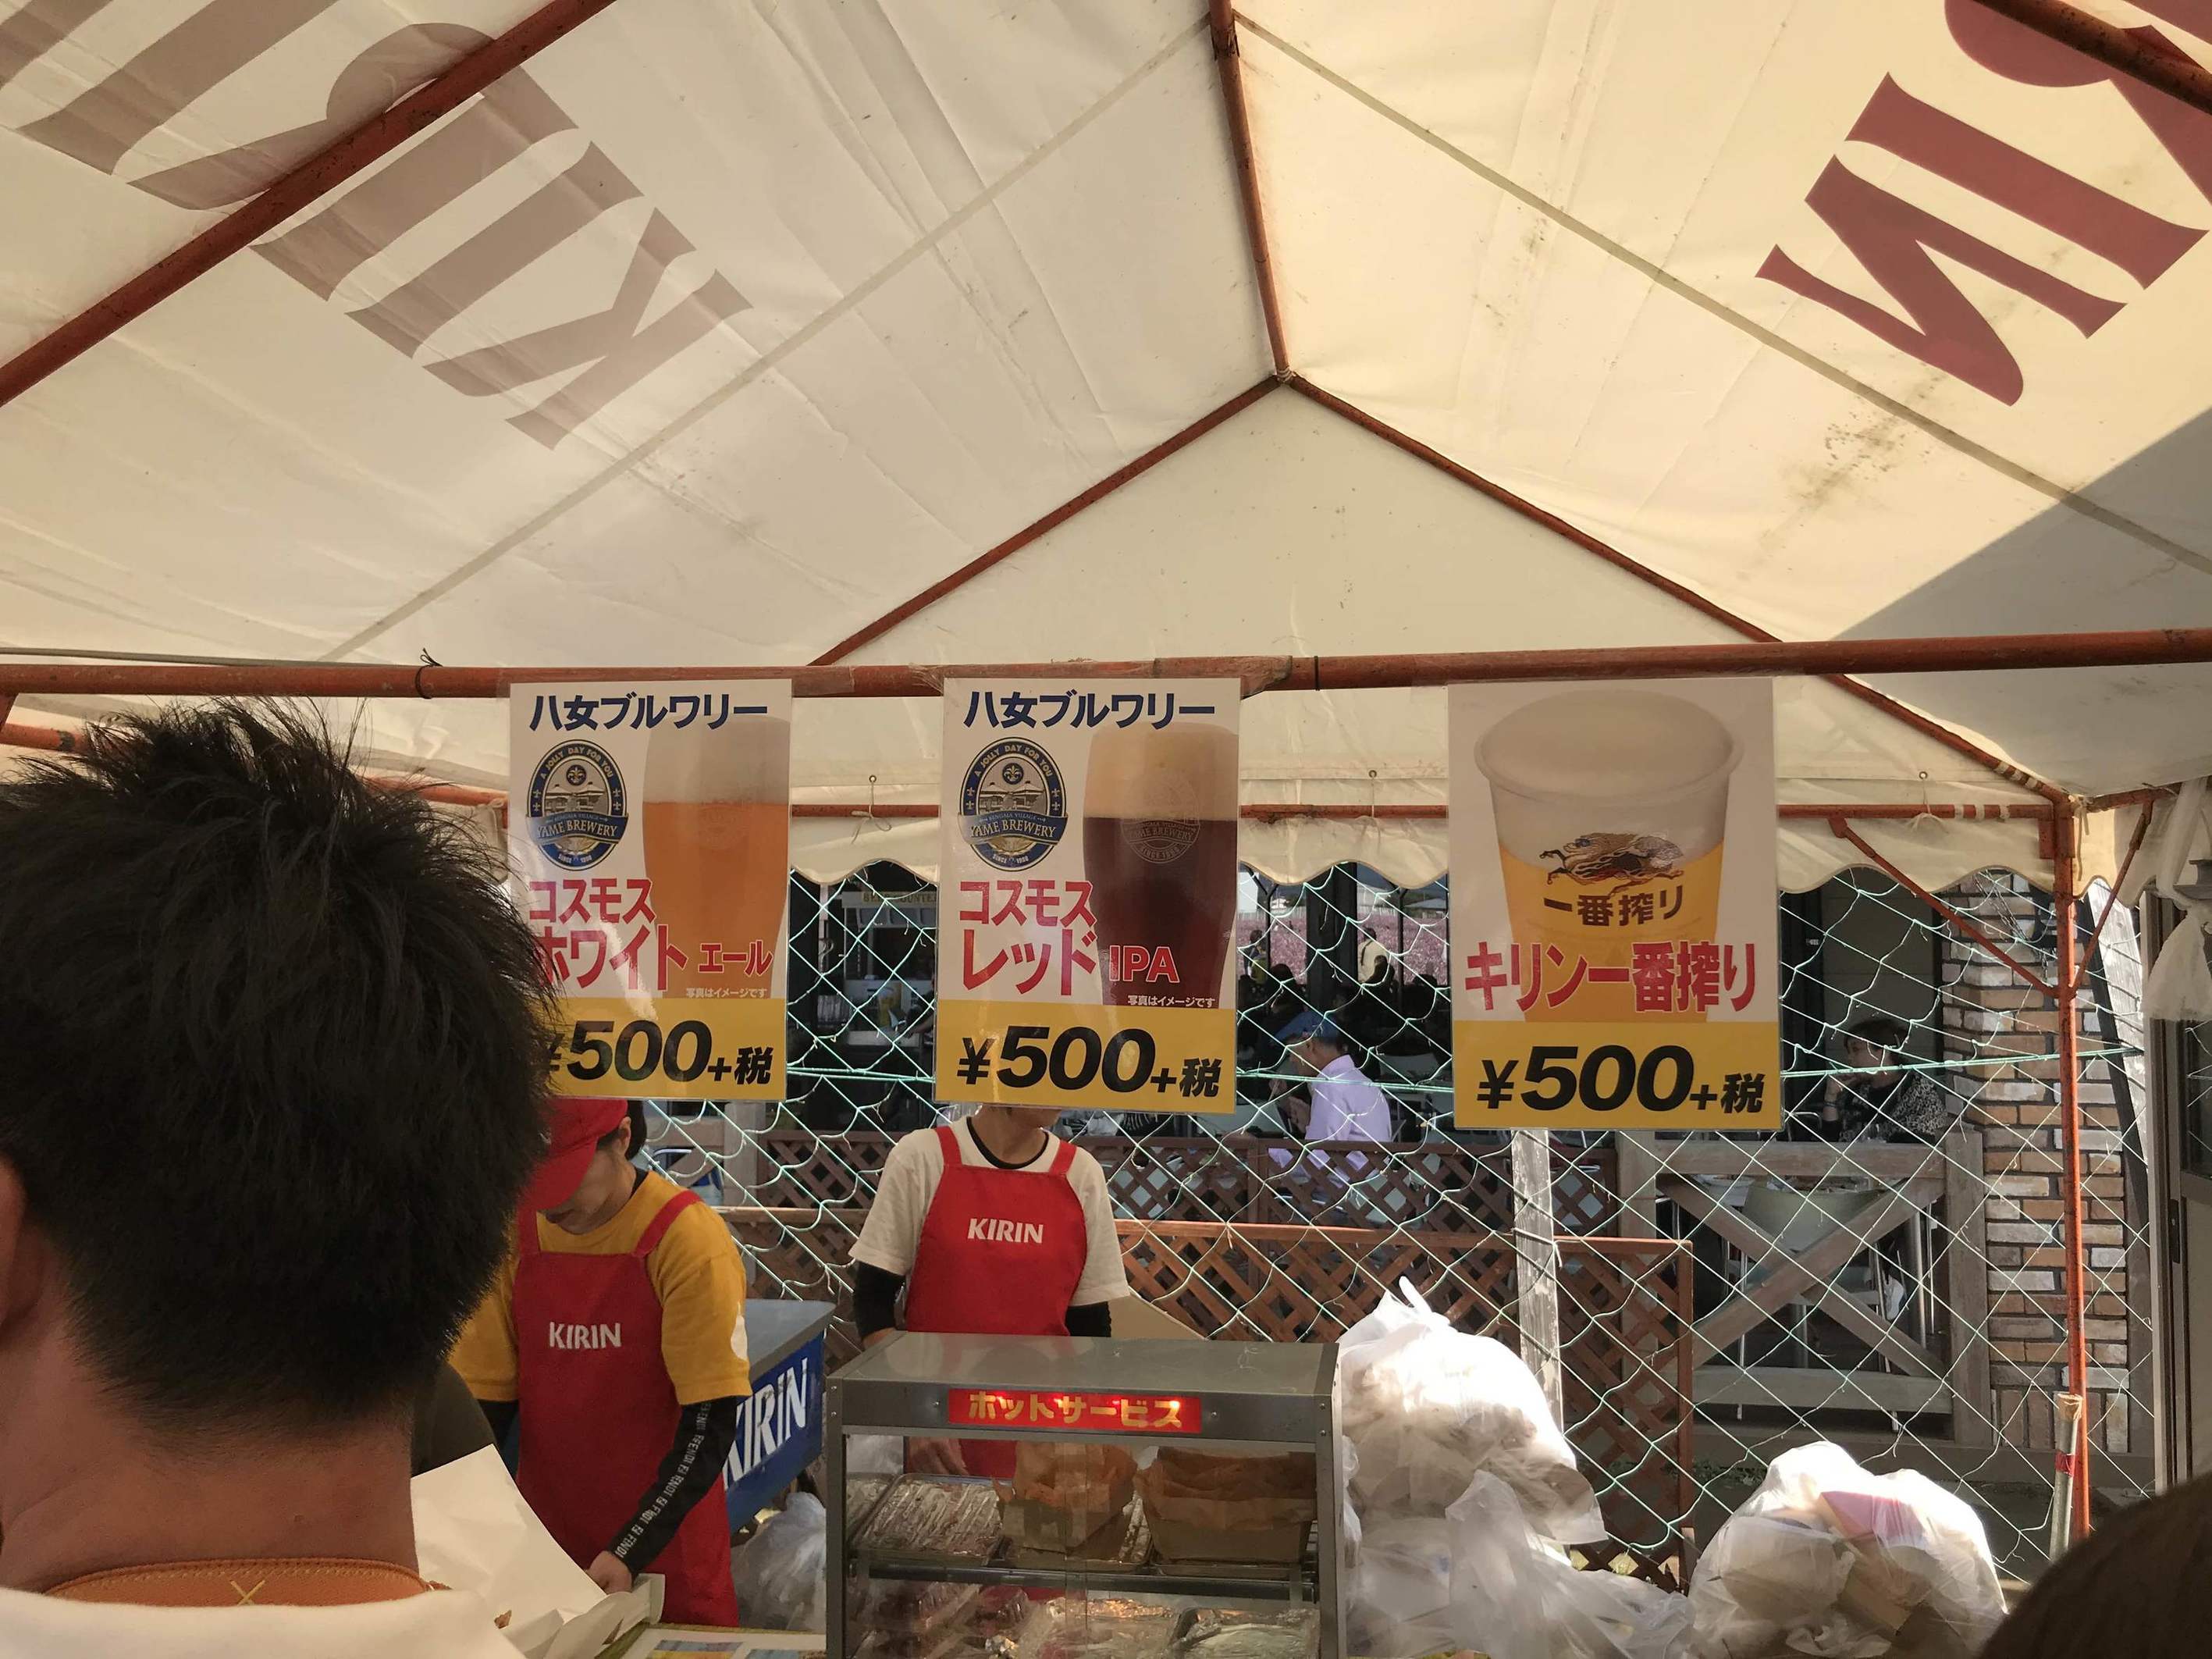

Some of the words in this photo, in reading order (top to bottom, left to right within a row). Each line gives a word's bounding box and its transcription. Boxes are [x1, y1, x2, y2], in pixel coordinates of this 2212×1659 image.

[529, 692, 767, 731] 八女ブルワリー
[963, 689, 1214, 730] 八女ブルワリー
[587, 749, 601, 762] FOR
[601, 763, 613, 778] YOU
[980, 749, 1000, 767] JOLLY
[1024, 746, 1039, 760] FOR
[1040, 761, 1053, 777] YOU
[538, 821, 566, 838] YAME
[567, 818, 617, 837] BREWERY
[970, 821, 1001, 838] YAME
[1002, 819, 1056, 838] BREWERY
[529, 878, 656, 924] コスモス
[959, 880, 1097, 927] コスモス
[1543, 885, 1683, 927] 一番搾り
[698, 941, 773, 976] エール
[962, 929, 1097, 996] レッド
[1108, 945, 1179, 984] IPA
[685, 987, 768, 999] 写真はイメージです
[1465, 942, 1756, 1013] キリン一番搾り
[1127, 994, 1216, 1008] 写真はイメージです
[967, 1217, 1044, 1244] KIRIN
[548, 1320, 621, 1350] KIRIN
[969, 1390, 1182, 1427] ホットサービス
[614, 1536, 638, 1558] FENDI
